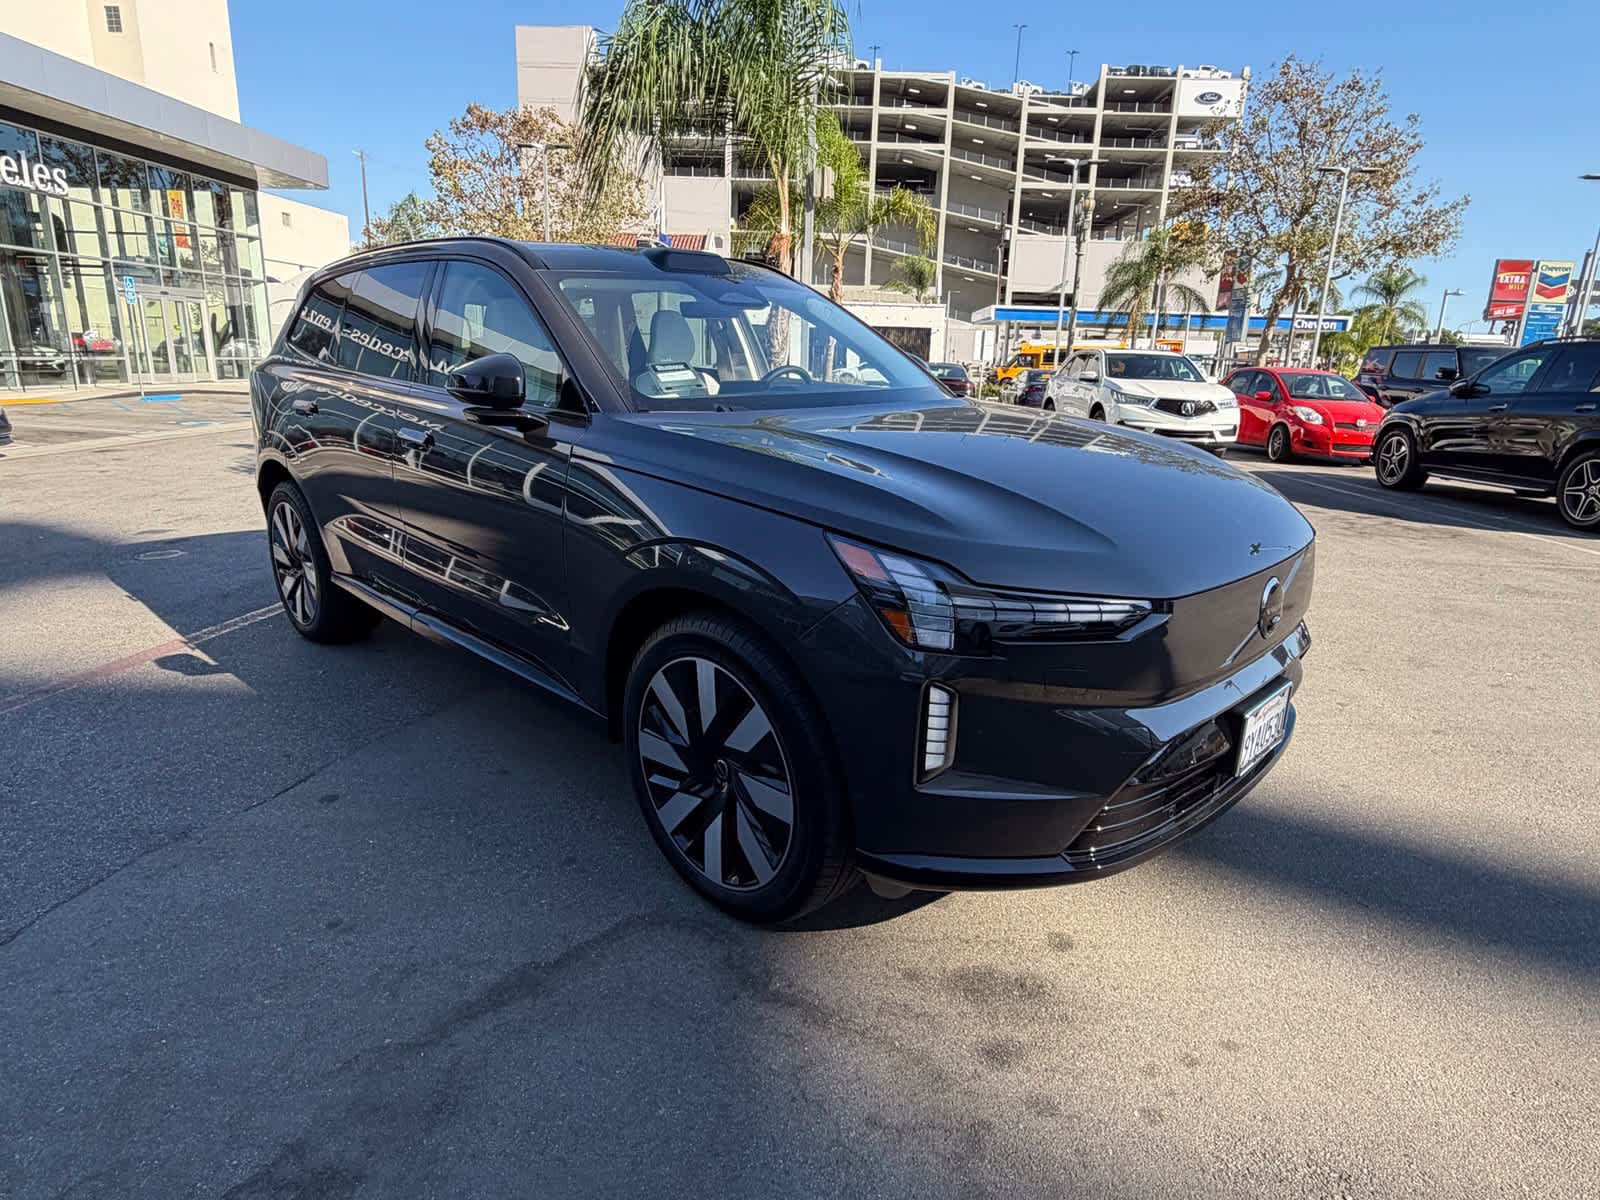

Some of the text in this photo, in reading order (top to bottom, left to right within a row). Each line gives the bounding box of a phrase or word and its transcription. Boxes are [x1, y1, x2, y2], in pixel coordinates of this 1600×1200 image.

[0, 150, 69, 196] eles
[1541, 264, 1572, 272] Chevron
[1499, 275, 1526, 284] EXTRA
